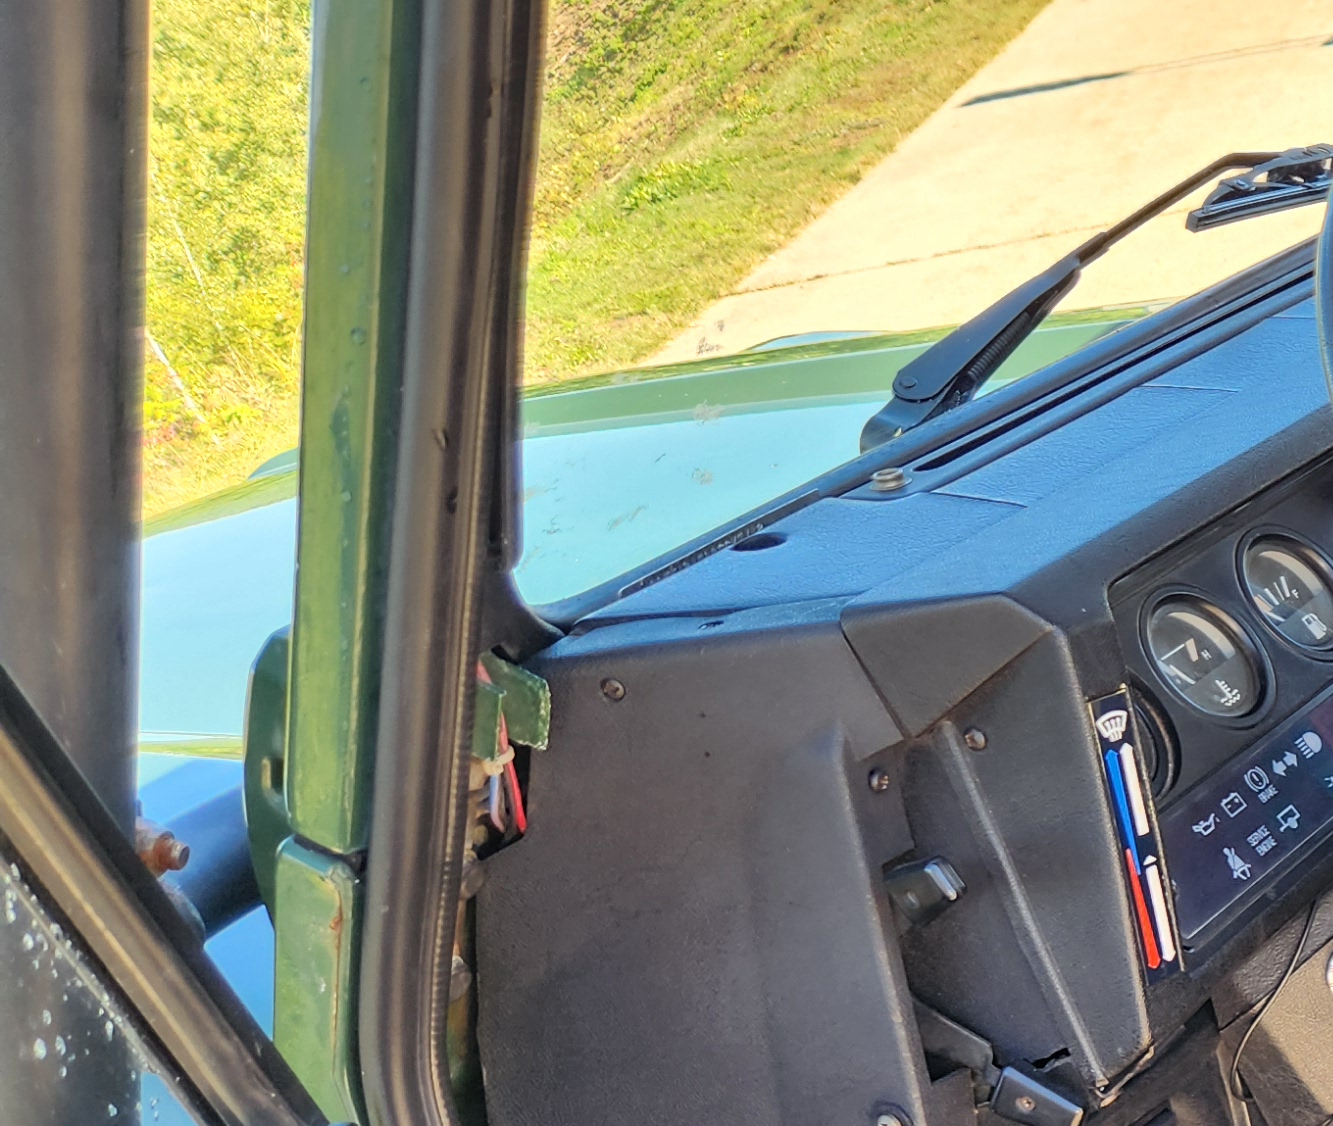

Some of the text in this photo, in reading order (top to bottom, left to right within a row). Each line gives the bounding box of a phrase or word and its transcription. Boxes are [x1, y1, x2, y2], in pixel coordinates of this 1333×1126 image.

[1291, 588, 1300, 599] F
[1201, 649, 1212, 661] H
[1257, 784, 1279, 804] BRAKE
[1246, 824, 1271, 847] SERVICE
[1255, 835, 1278, 857] ENGINE
